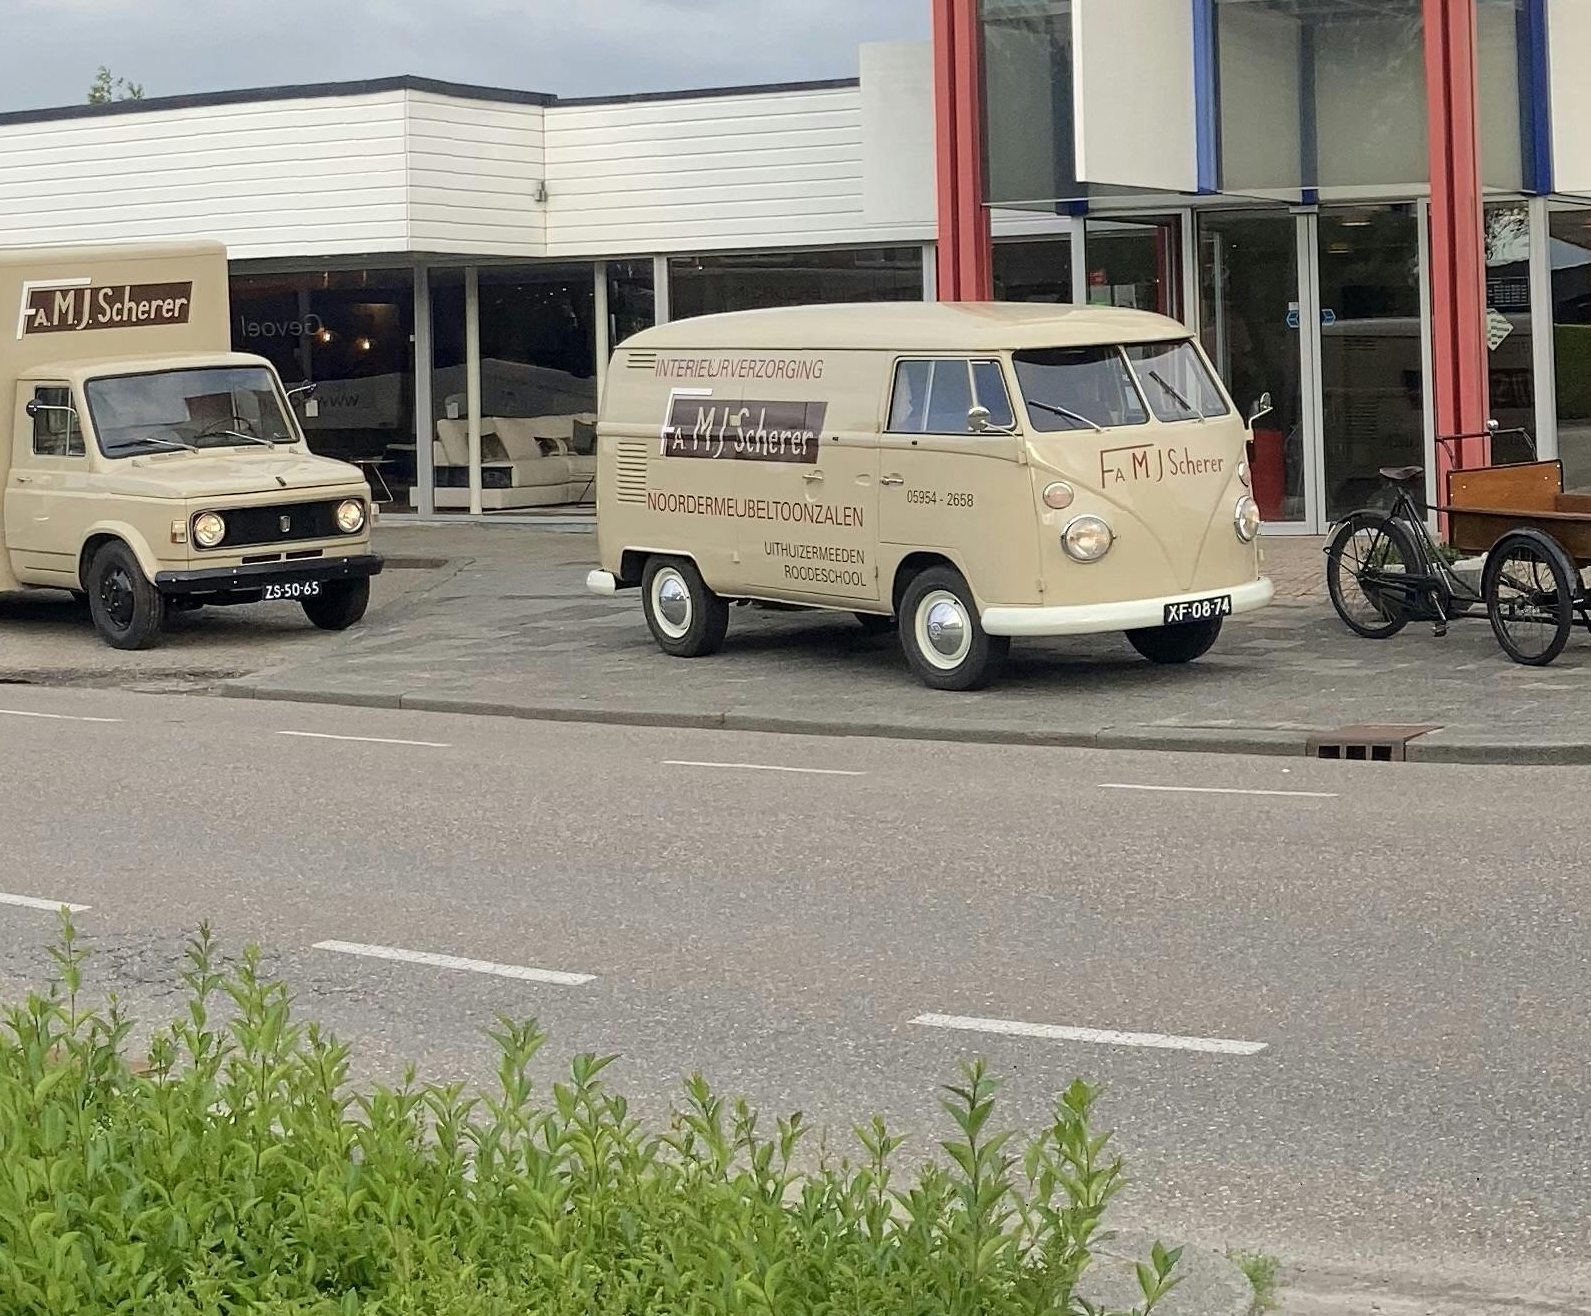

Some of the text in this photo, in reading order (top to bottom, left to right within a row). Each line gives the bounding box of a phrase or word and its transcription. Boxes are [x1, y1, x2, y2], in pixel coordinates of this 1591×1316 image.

[98, 286, 188, 323] Scherer
[656, 359, 824, 380] INTERIEURVERZORGING
[734, 407, 814, 456] Scherer
[1168, 447, 1223, 476] Scherer
[647, 492, 864, 527] NOORDERMEUBELTOONZALEN
[907, 489, 936, 505] 05954
[947, 492, 974, 507] 2658
[764, 541, 865, 565] UITHUIZERMEEDEN
[784, 564, 867, 587] ROODESCHOOL
[265, 581, 319, 599] ZS-50-65
[1168, 597, 1230, 622] XF-08-74
